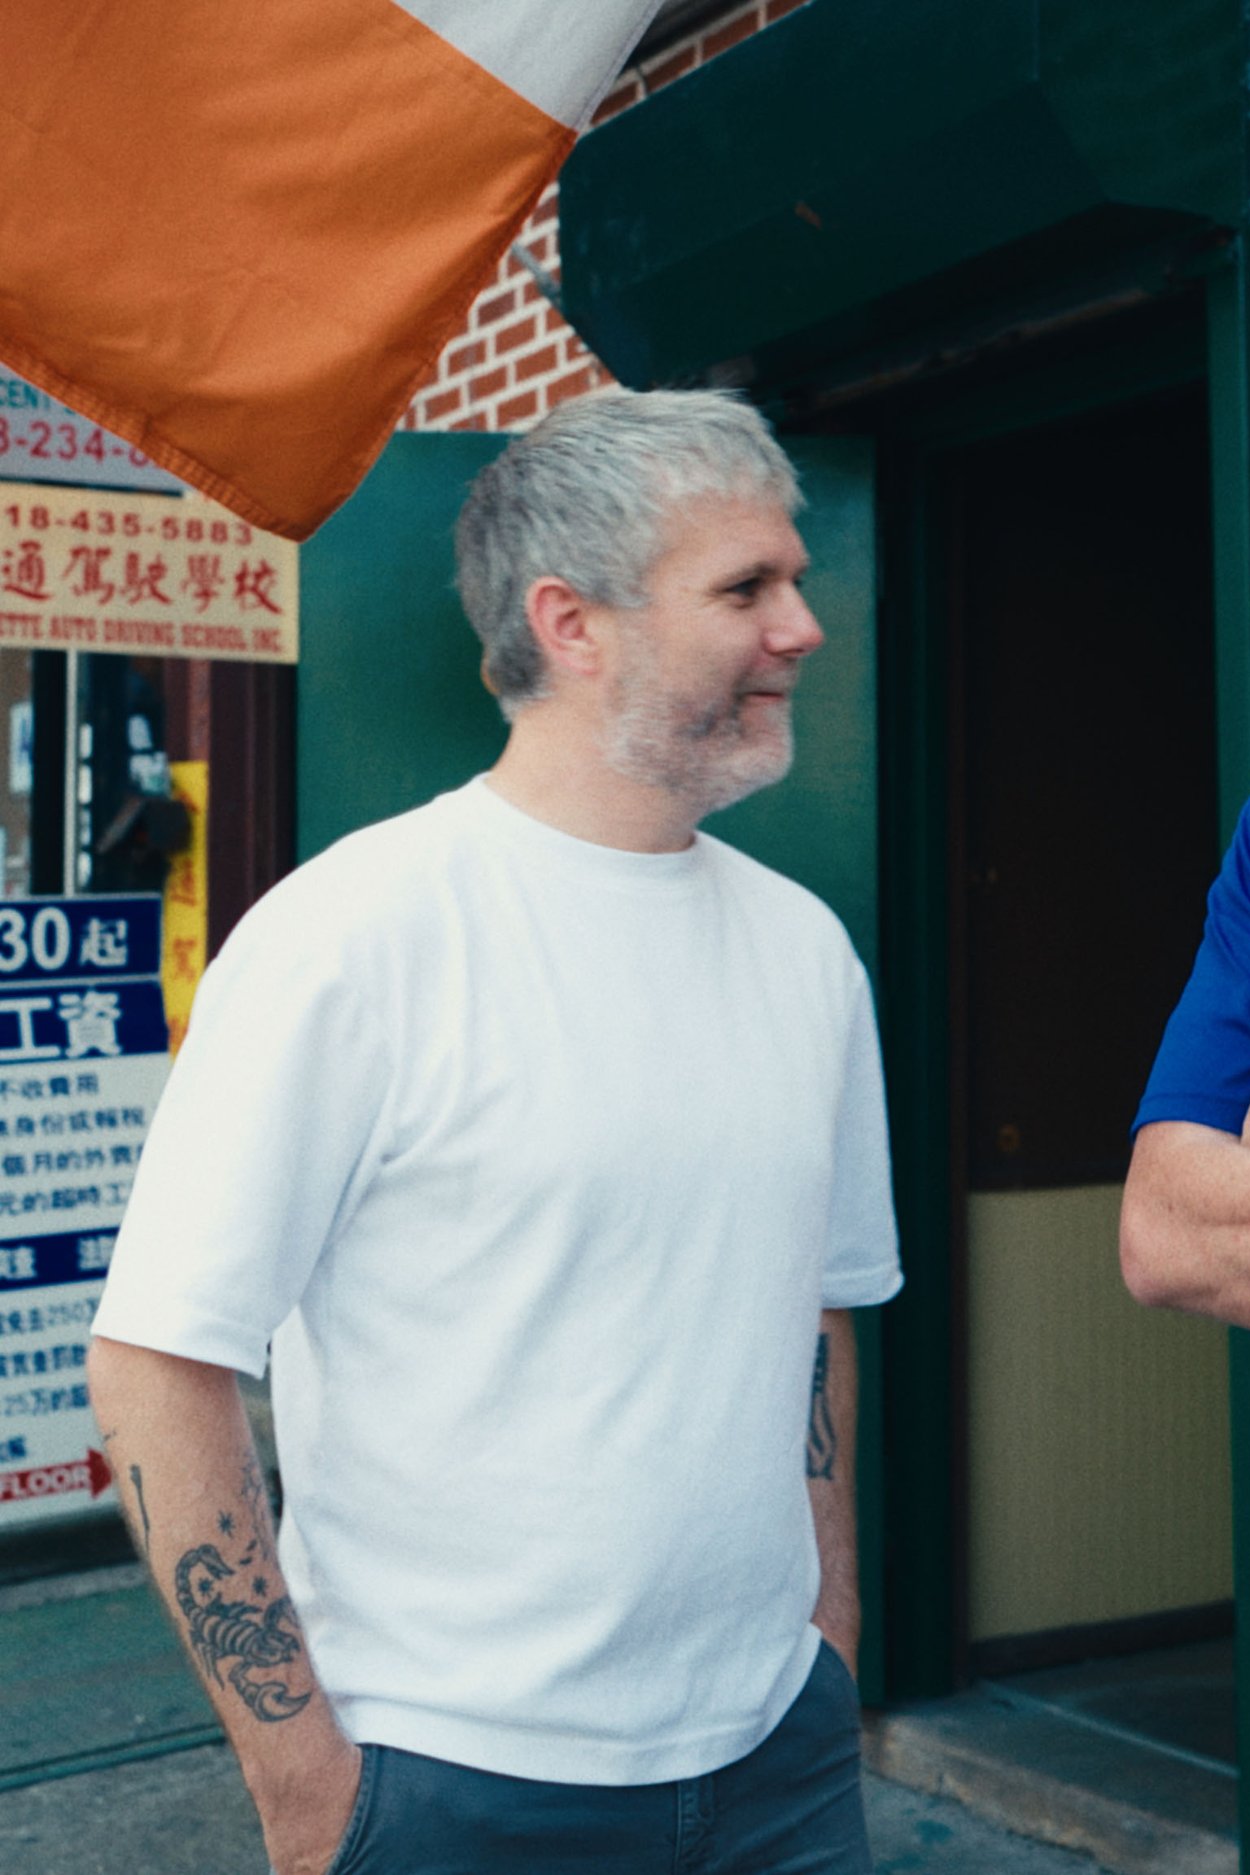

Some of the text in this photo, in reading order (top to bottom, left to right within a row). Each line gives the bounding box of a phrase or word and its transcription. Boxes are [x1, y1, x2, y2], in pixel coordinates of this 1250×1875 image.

[0, 540, 282, 615] 通駕駛學校
[50, 616, 96, 642] AUTO
[103, 618, 174, 647] DRIVING
[181, 624, 247, 650] SCHOOL
